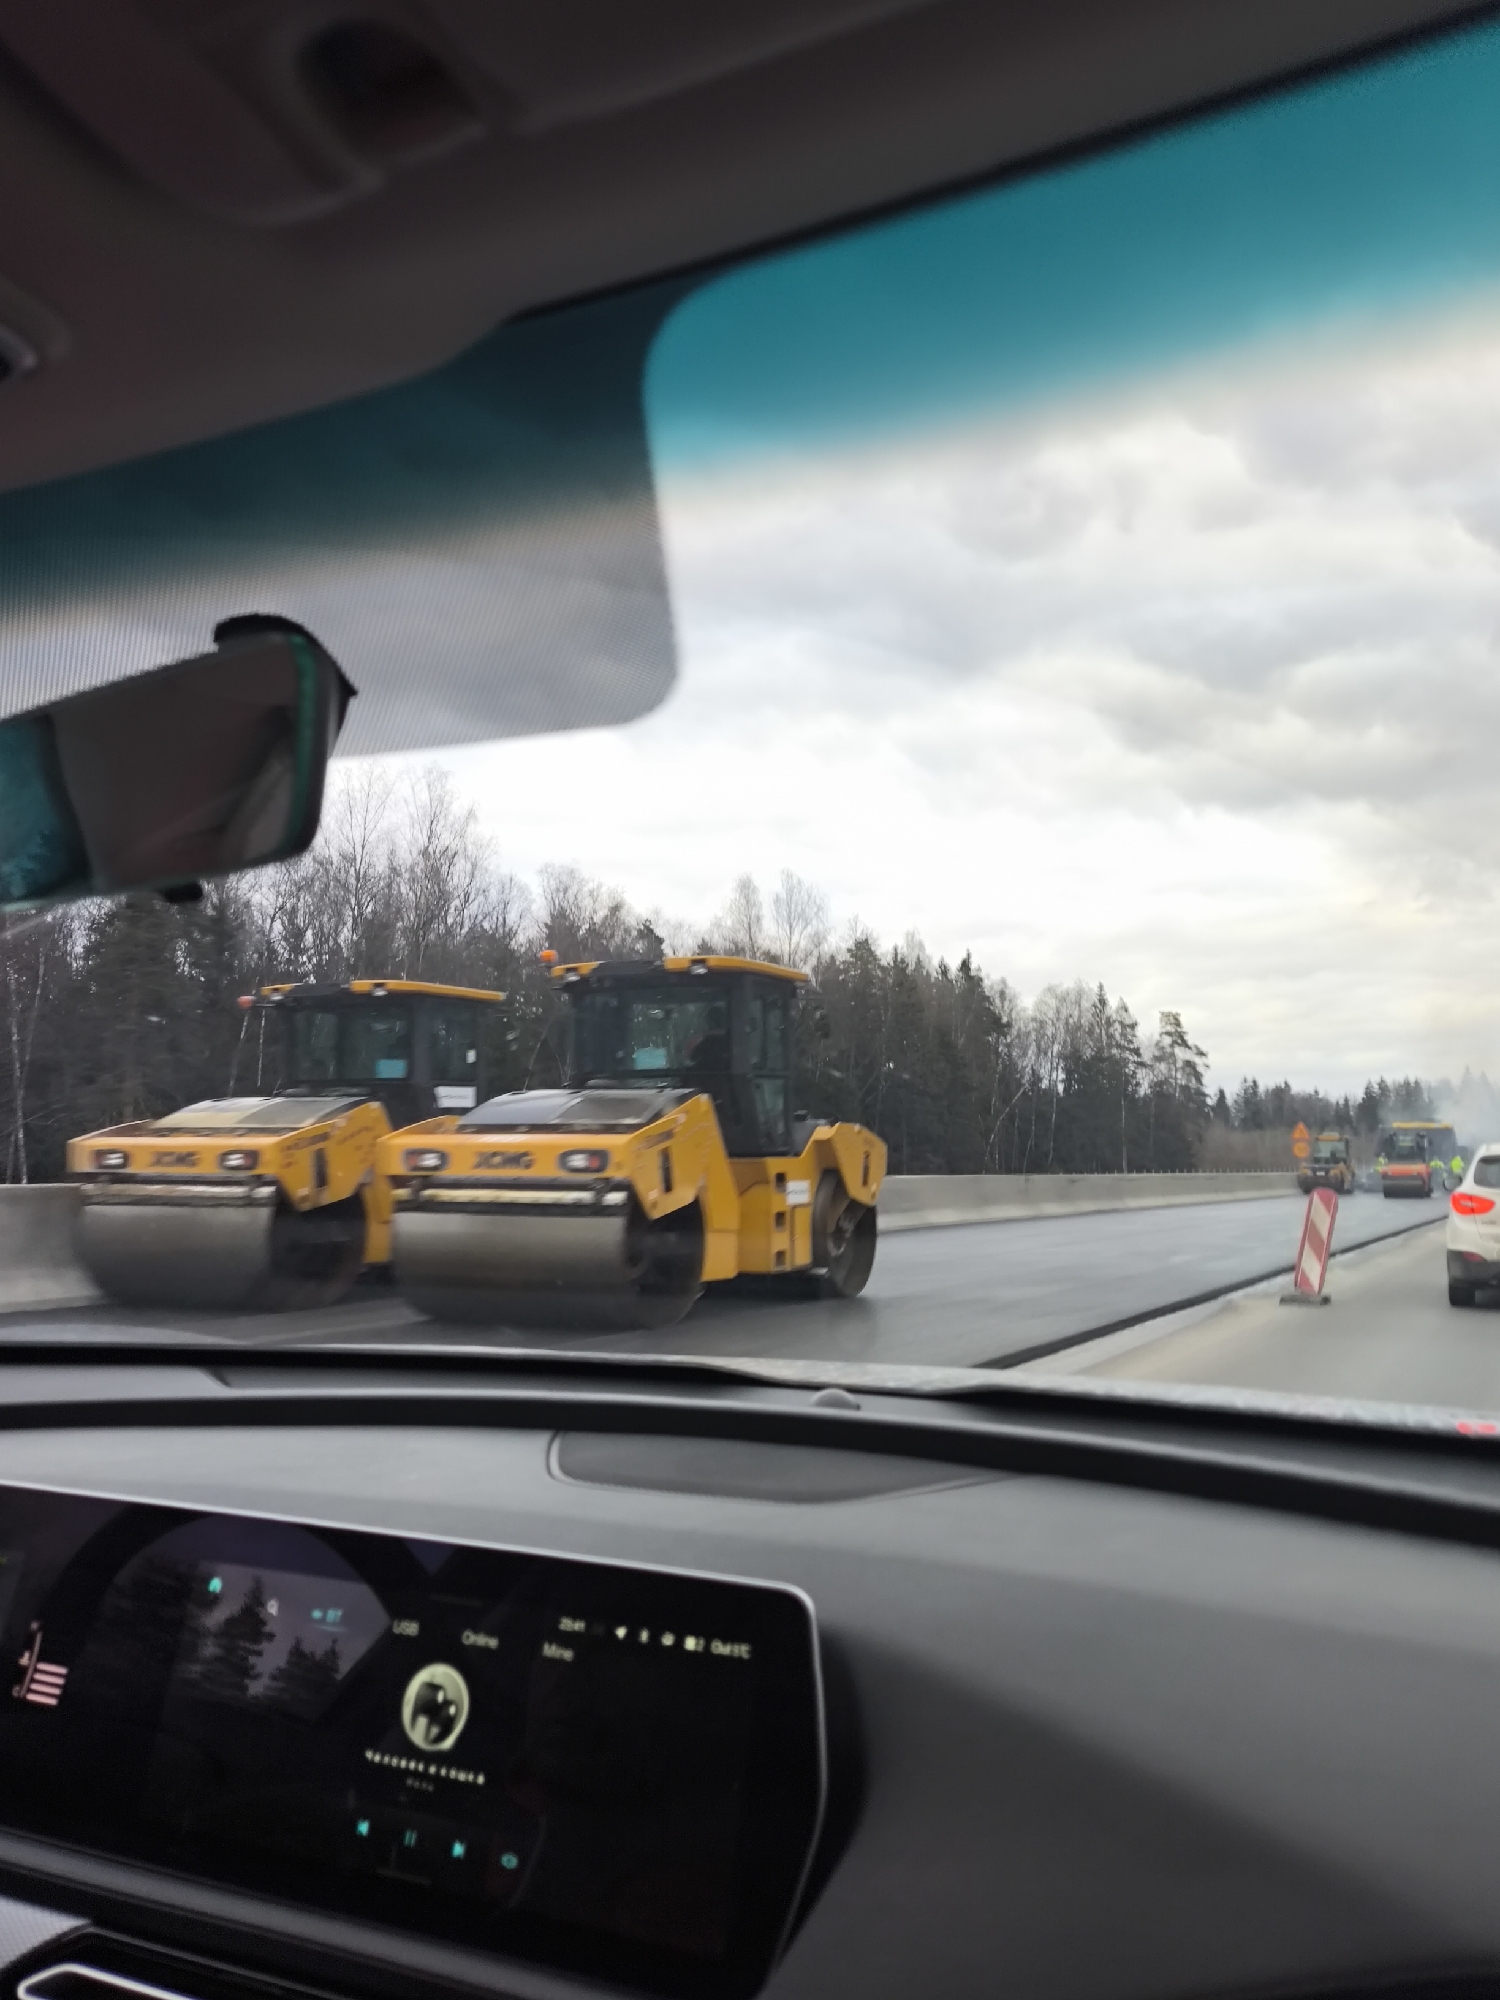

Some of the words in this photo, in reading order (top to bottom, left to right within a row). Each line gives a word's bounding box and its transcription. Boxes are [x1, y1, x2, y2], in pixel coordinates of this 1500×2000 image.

[392, 1618, 420, 1637] USB
[461, 1629, 499, 1650] Online
[542, 1641, 574, 1662] Mine
